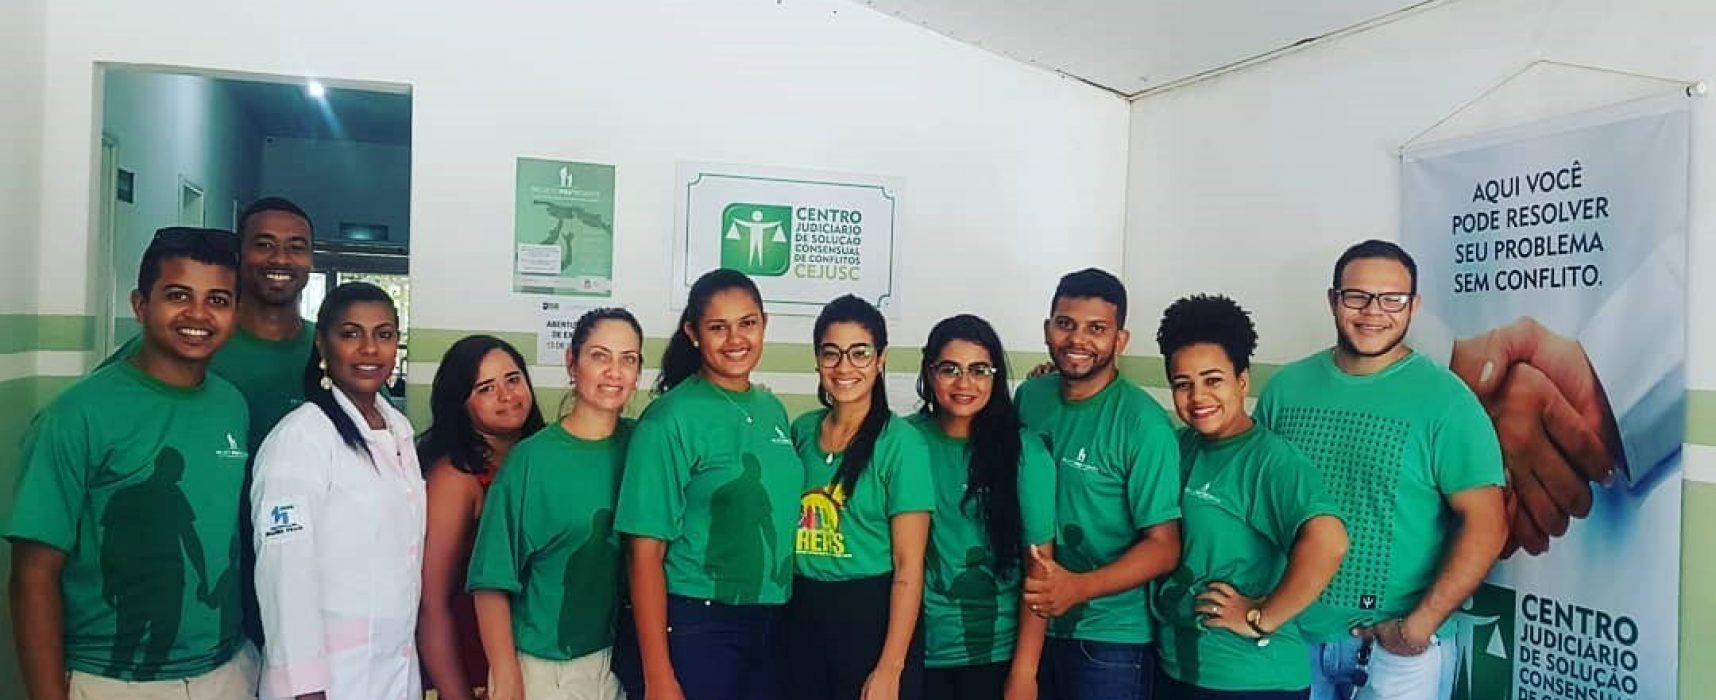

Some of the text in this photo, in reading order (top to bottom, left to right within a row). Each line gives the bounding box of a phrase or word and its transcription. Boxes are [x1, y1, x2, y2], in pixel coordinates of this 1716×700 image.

[1472, 160, 1582, 204] AQUI VOCÊ
[796, 207, 862, 223] CENTRO
[1452, 196, 1609, 235] PODE RESOLVER
[795, 233, 808, 242] DE
[795, 244, 860, 255] CONSENSUAL
[1454, 231, 1604, 264] SEU PROBLEMA
[794, 253, 861, 266] DE CONFLITOS
[794, 264, 861, 280] CEJUSC
[1454, 264, 1602, 293] SEM CONFLITO.
[1521, 593, 1639, 647] CENTRO
[1519, 622, 1639, 672] JUDICIÁRIO
[1520, 645, 1639, 695] DE SOLUÇÃO
